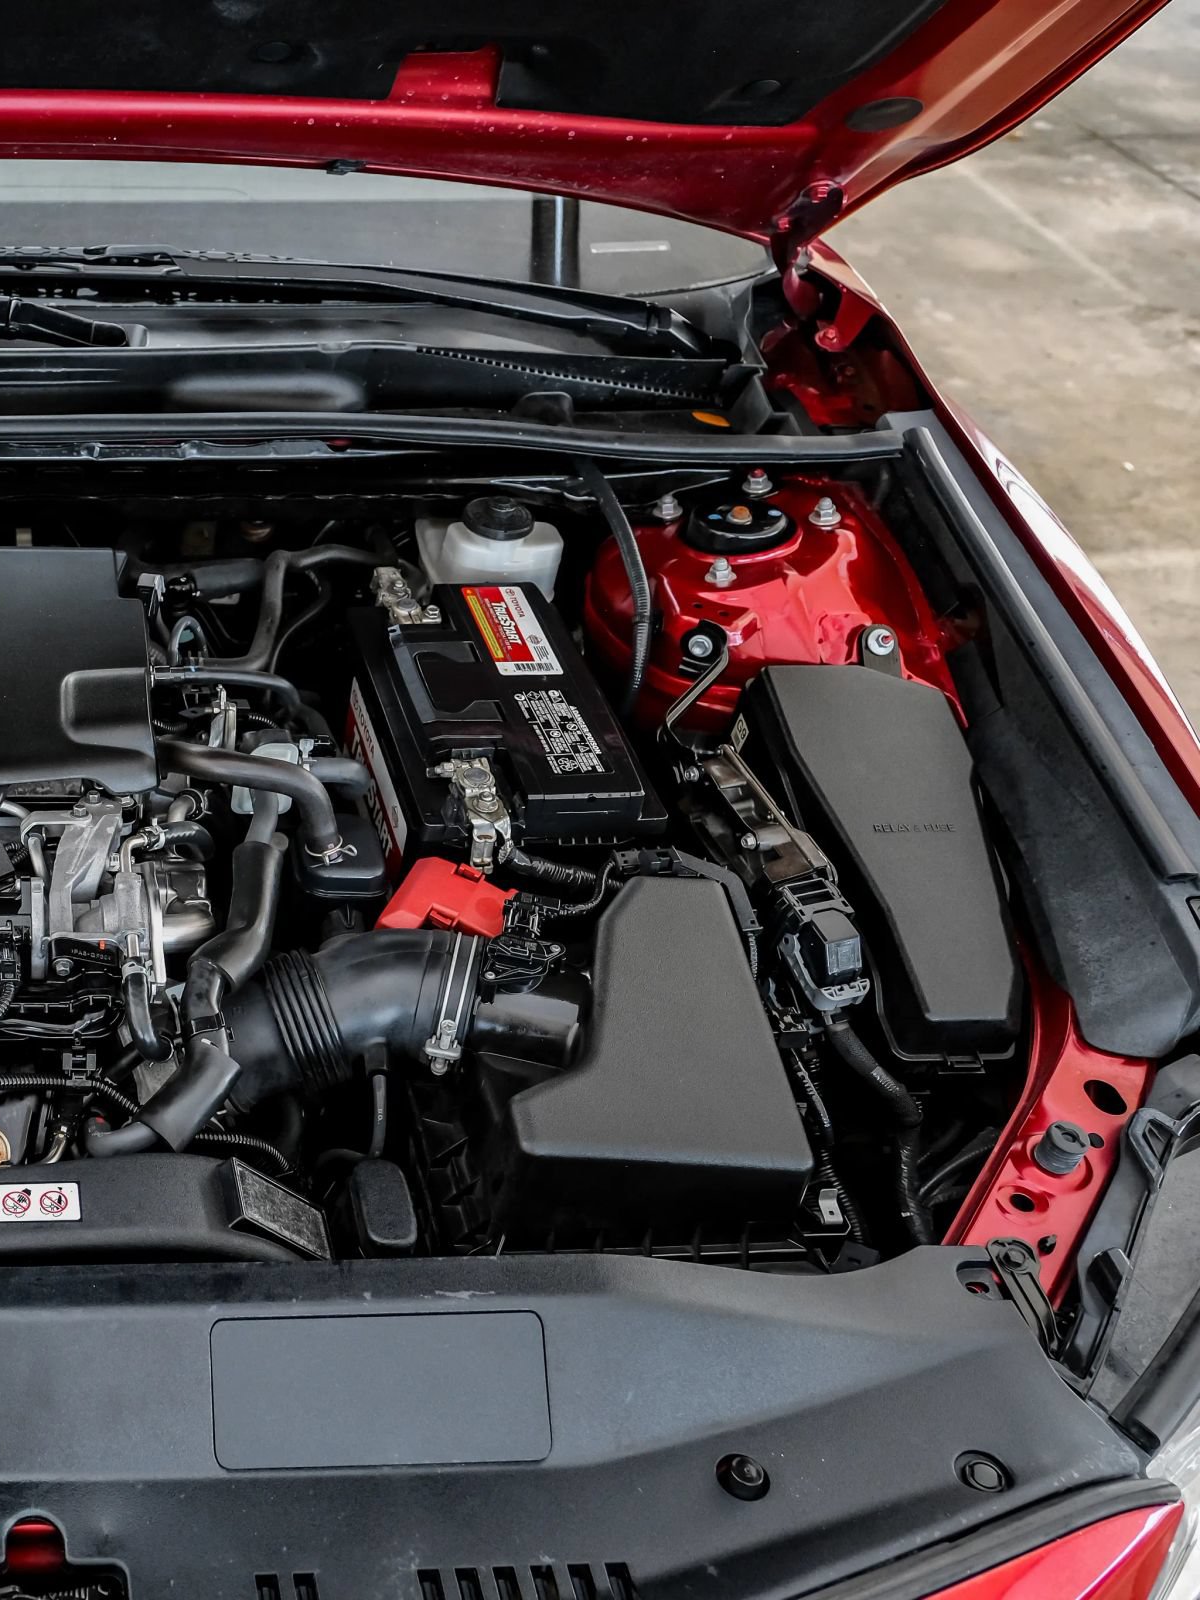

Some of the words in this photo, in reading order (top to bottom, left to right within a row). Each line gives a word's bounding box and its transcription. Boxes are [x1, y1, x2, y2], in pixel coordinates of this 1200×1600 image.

[509, 597, 525, 618] TOYOTA
[356, 704, 375, 758] TOYOTA
[351, 723, 394, 859] TRSTART
[872, 823, 911, 833] RELAY
[923, 823, 957, 833] FUSE
